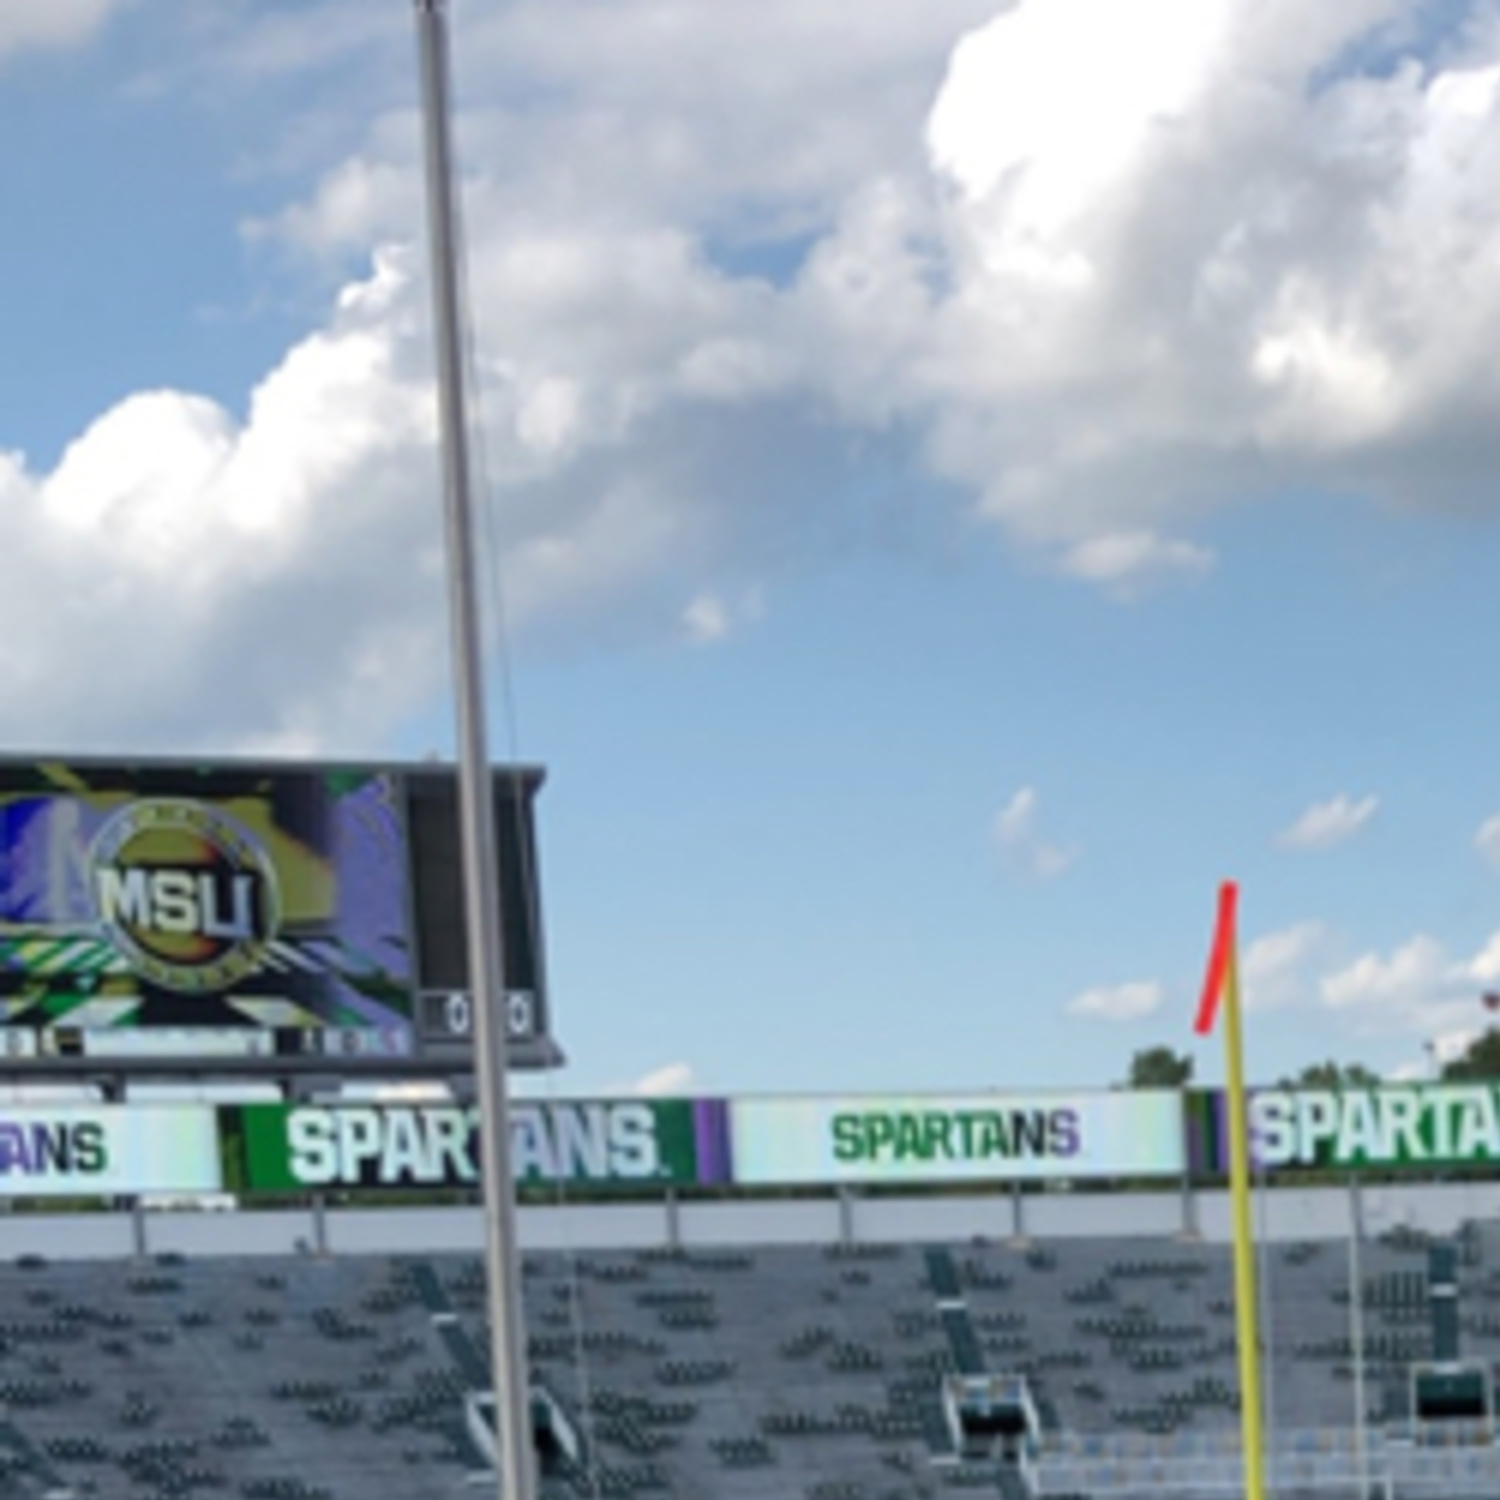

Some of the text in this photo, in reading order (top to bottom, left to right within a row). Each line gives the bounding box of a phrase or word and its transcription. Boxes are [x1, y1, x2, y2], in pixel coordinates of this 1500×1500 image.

[97, 866, 256, 939] MSU
[286, 1103, 661, 1184] SPARANS
[831, 1106, 1081, 1163] SPARTANS
